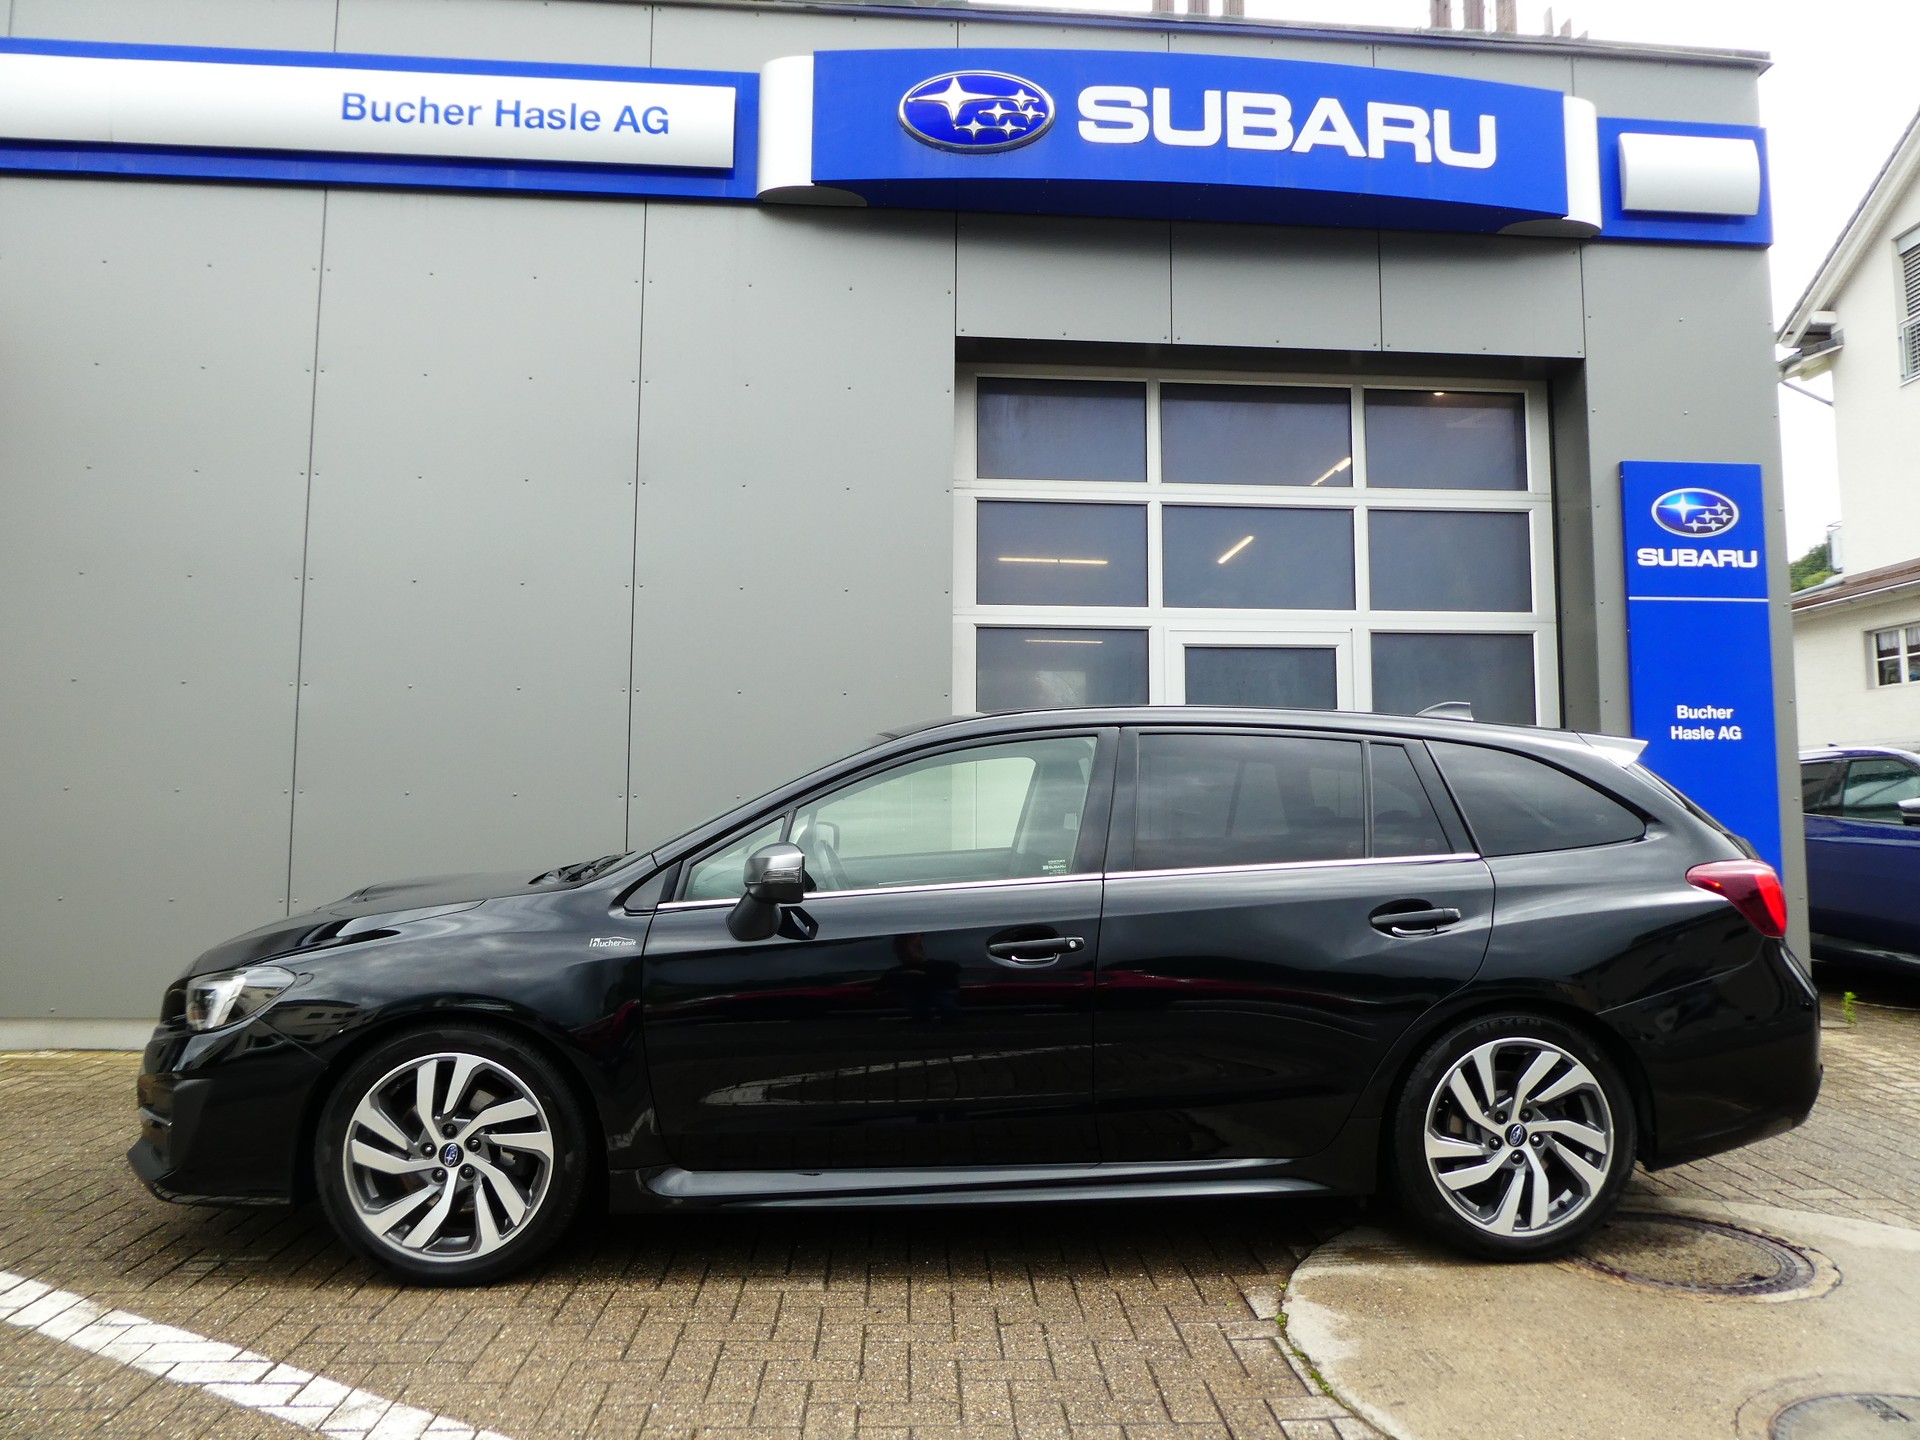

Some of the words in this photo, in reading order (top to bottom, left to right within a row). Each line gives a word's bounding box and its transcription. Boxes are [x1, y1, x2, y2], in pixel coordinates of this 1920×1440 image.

[341, 92, 482, 126] Bucher
[495, 99, 601, 132] Hasle
[613, 105, 670, 135] AG
[1077, 85, 1497, 169] SUBARU
[1637, 548, 1758, 568] SUBARU
[1676, 704, 1734, 720] Bucher
[1670, 725, 1714, 740] Hasle
[1718, 725, 1742, 741] AG
[1475, 1018, 1542, 1033] NEXEN
